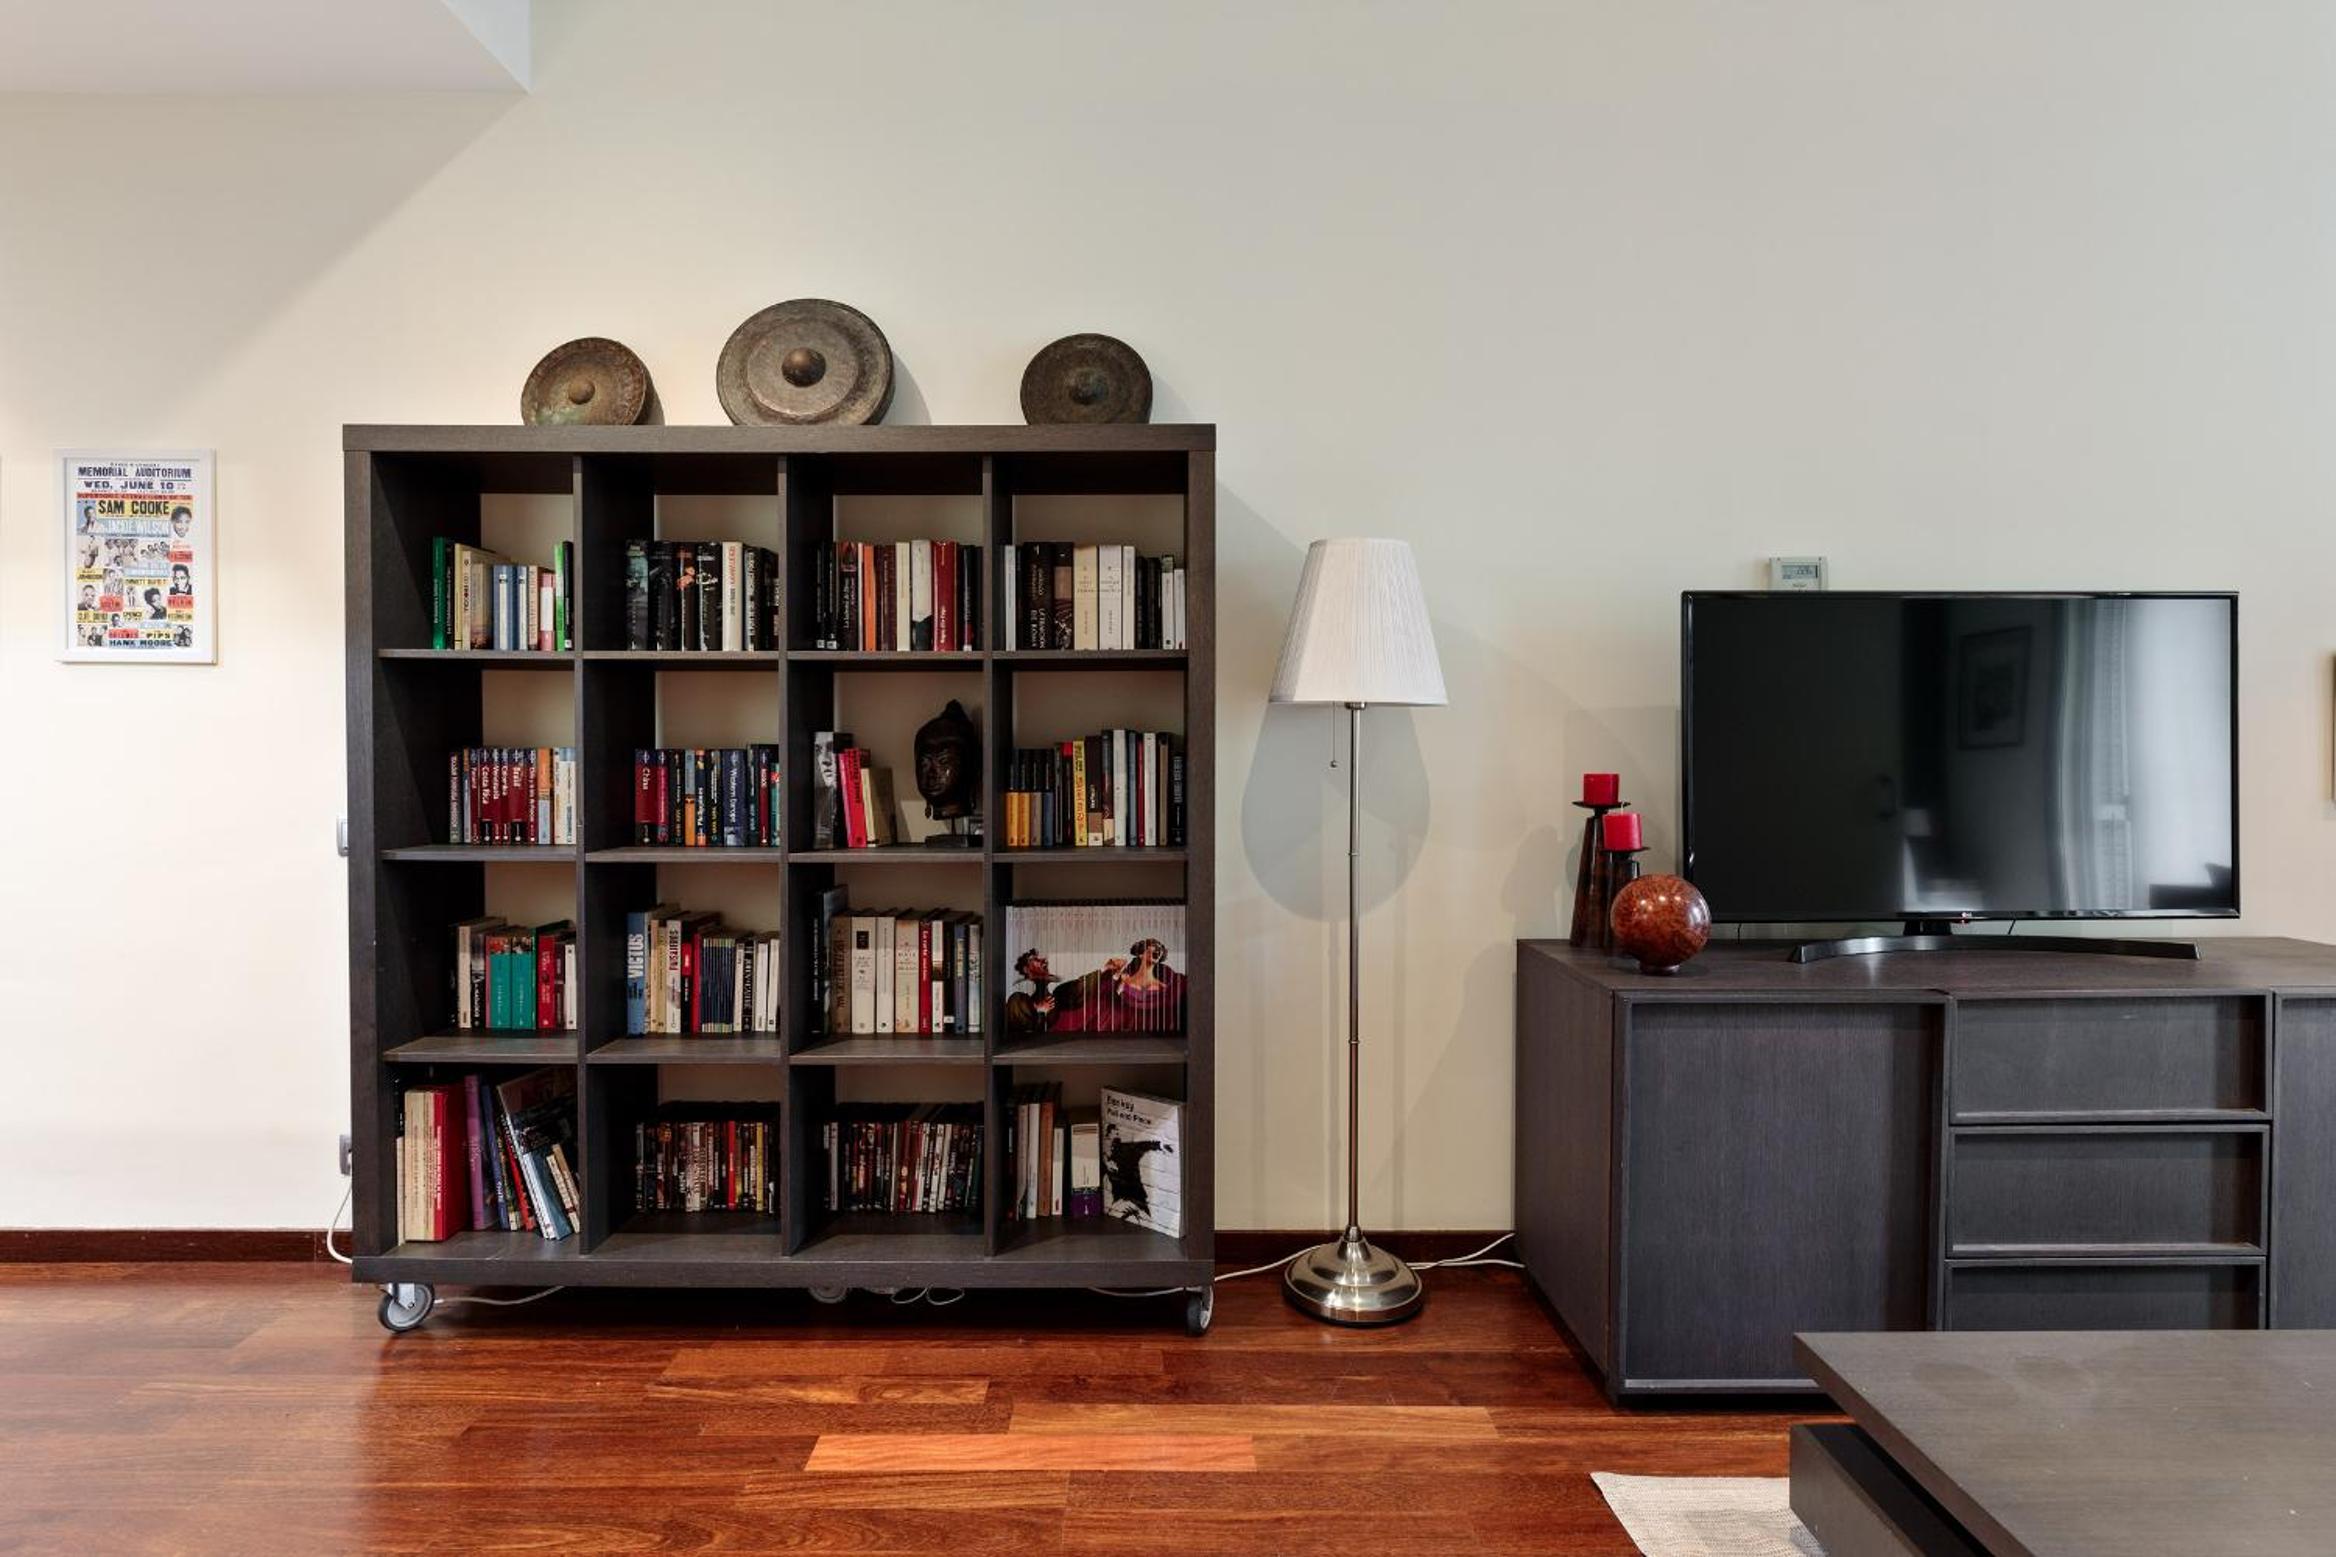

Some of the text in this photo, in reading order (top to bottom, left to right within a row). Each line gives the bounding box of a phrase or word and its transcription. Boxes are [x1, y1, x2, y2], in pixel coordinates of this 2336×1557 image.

[78, 467, 191, 478] MEMORIAL AUDITORIUM
[120, 481, 154, 489] JUNE
[98, 500, 170, 515] SAM COOKE
[642, 768, 650, 790] China
[729, 798, 738, 823] Europe
[627, 933, 644, 979] VICTUS
